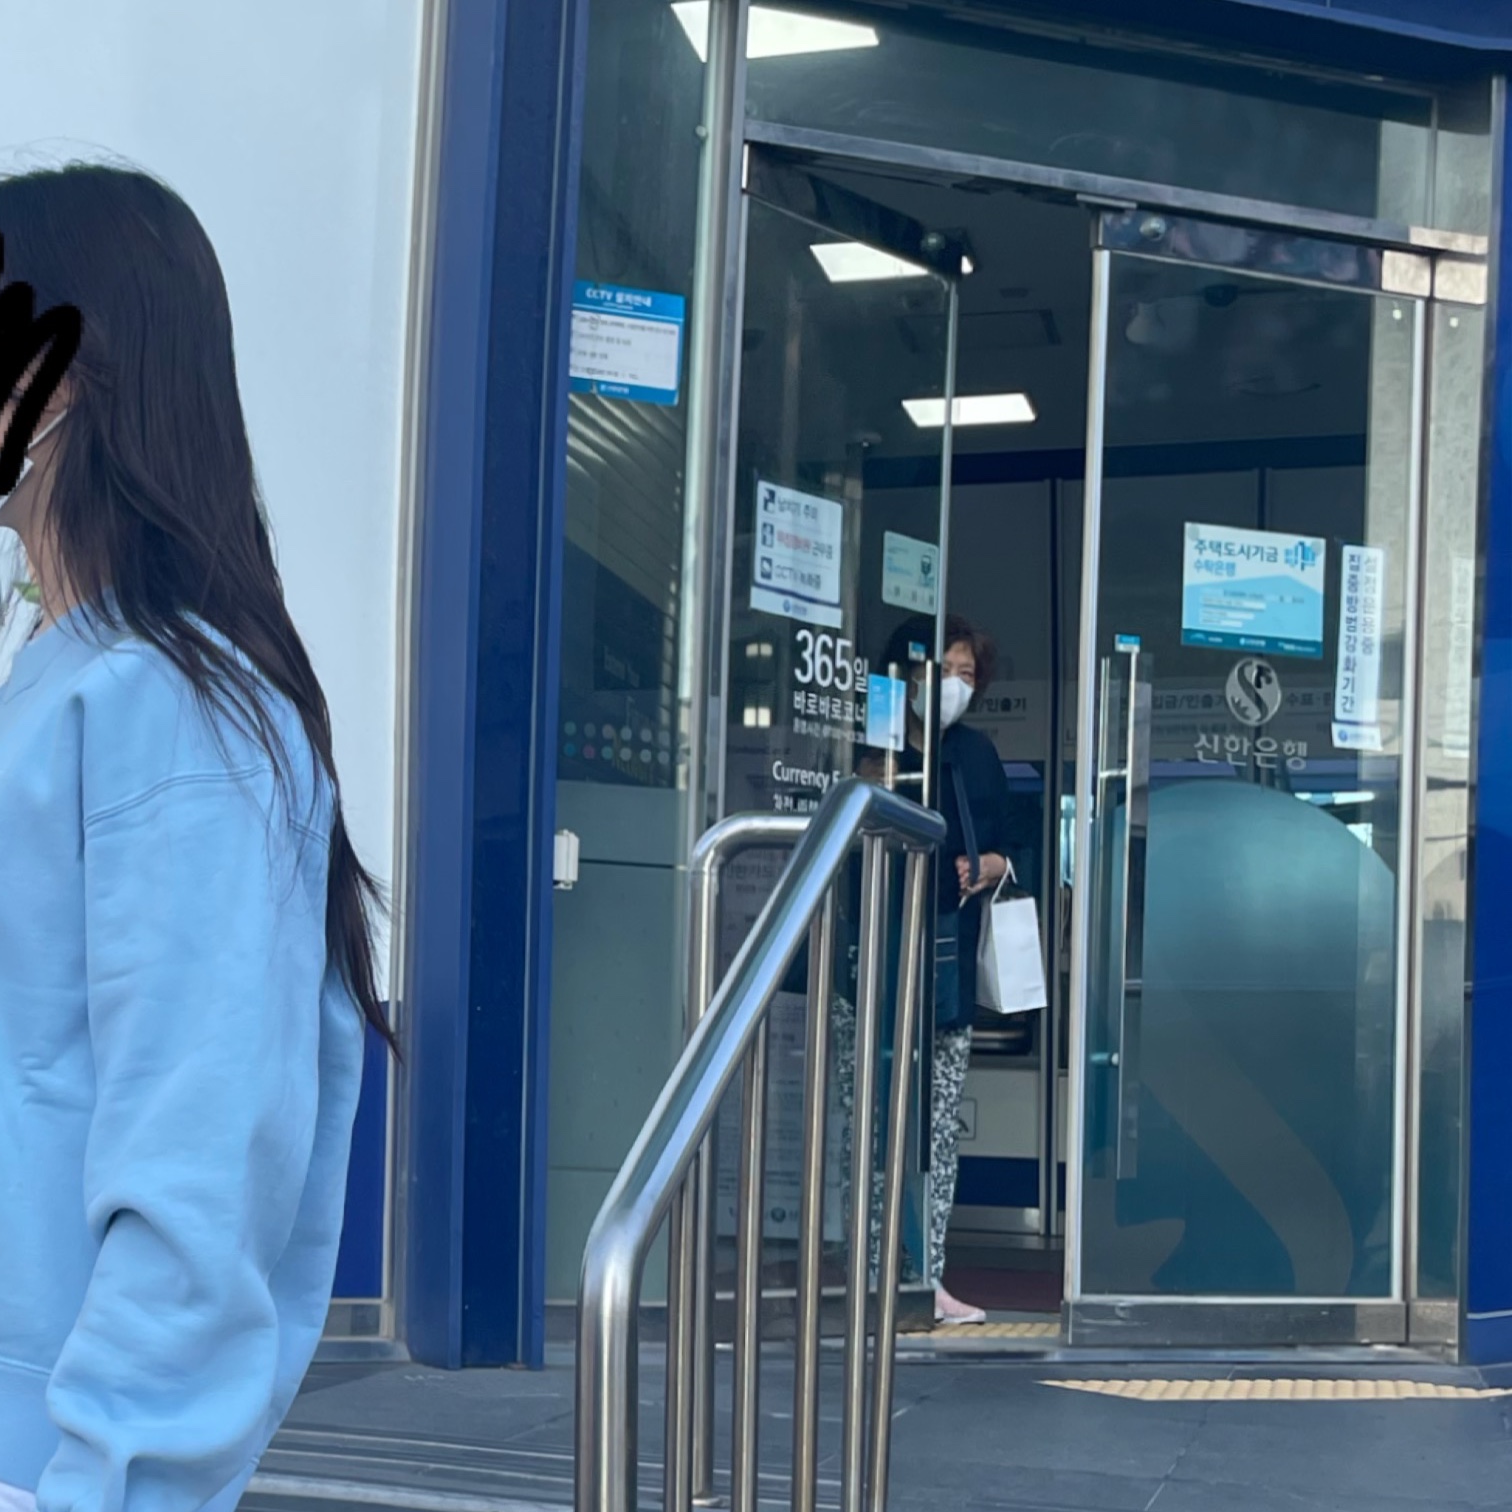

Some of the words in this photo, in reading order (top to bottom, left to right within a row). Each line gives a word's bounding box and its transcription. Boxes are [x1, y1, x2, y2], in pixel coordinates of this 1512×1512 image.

[1193, 537, 1279, 563] 주택도시기금
[793, 628, 870, 694] 365일
[792, 690, 868, 730] 바로바로코너
[1193, 731, 1309, 771] 신한은행
[772, 760, 830, 794] Currency
